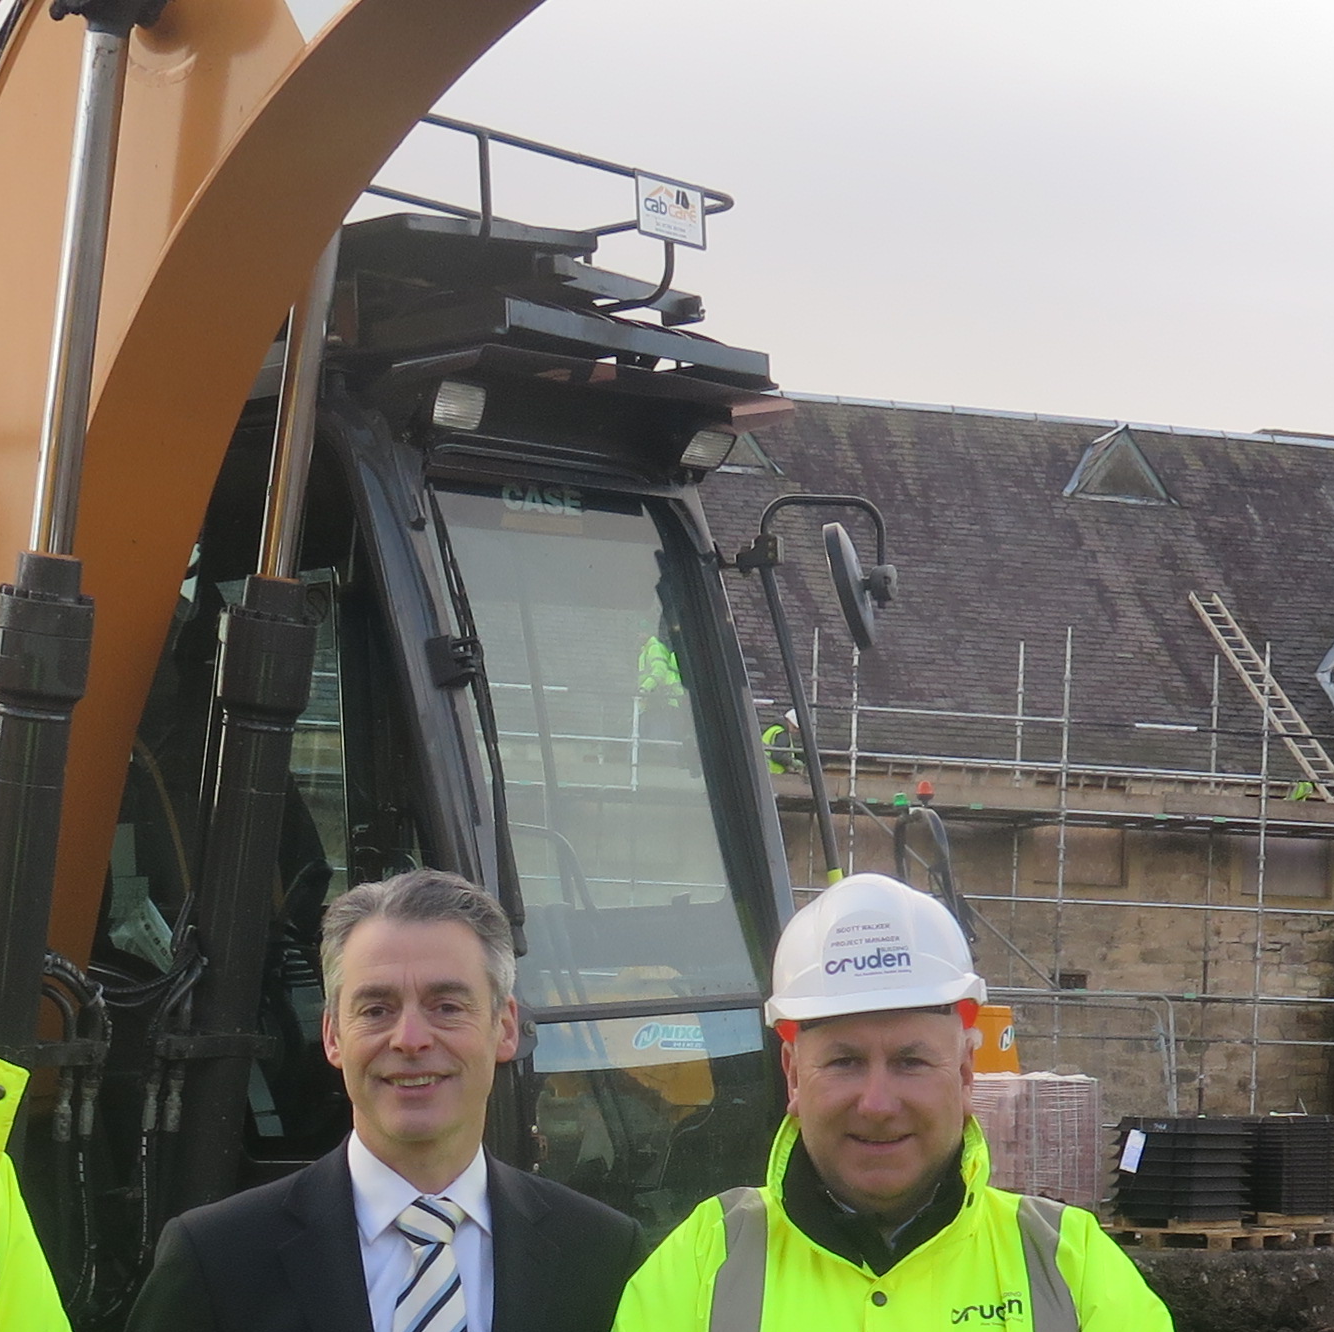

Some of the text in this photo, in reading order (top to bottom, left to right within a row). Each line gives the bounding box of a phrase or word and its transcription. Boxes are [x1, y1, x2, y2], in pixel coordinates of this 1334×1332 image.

[502, 484, 582, 515] CASE
[836, 925, 859, 934] SCOTT
[831, 935, 900, 947] PROJECT MANAGER
[825, 947, 911, 975] cruden
[661, 1025, 703, 1039] NIXO
